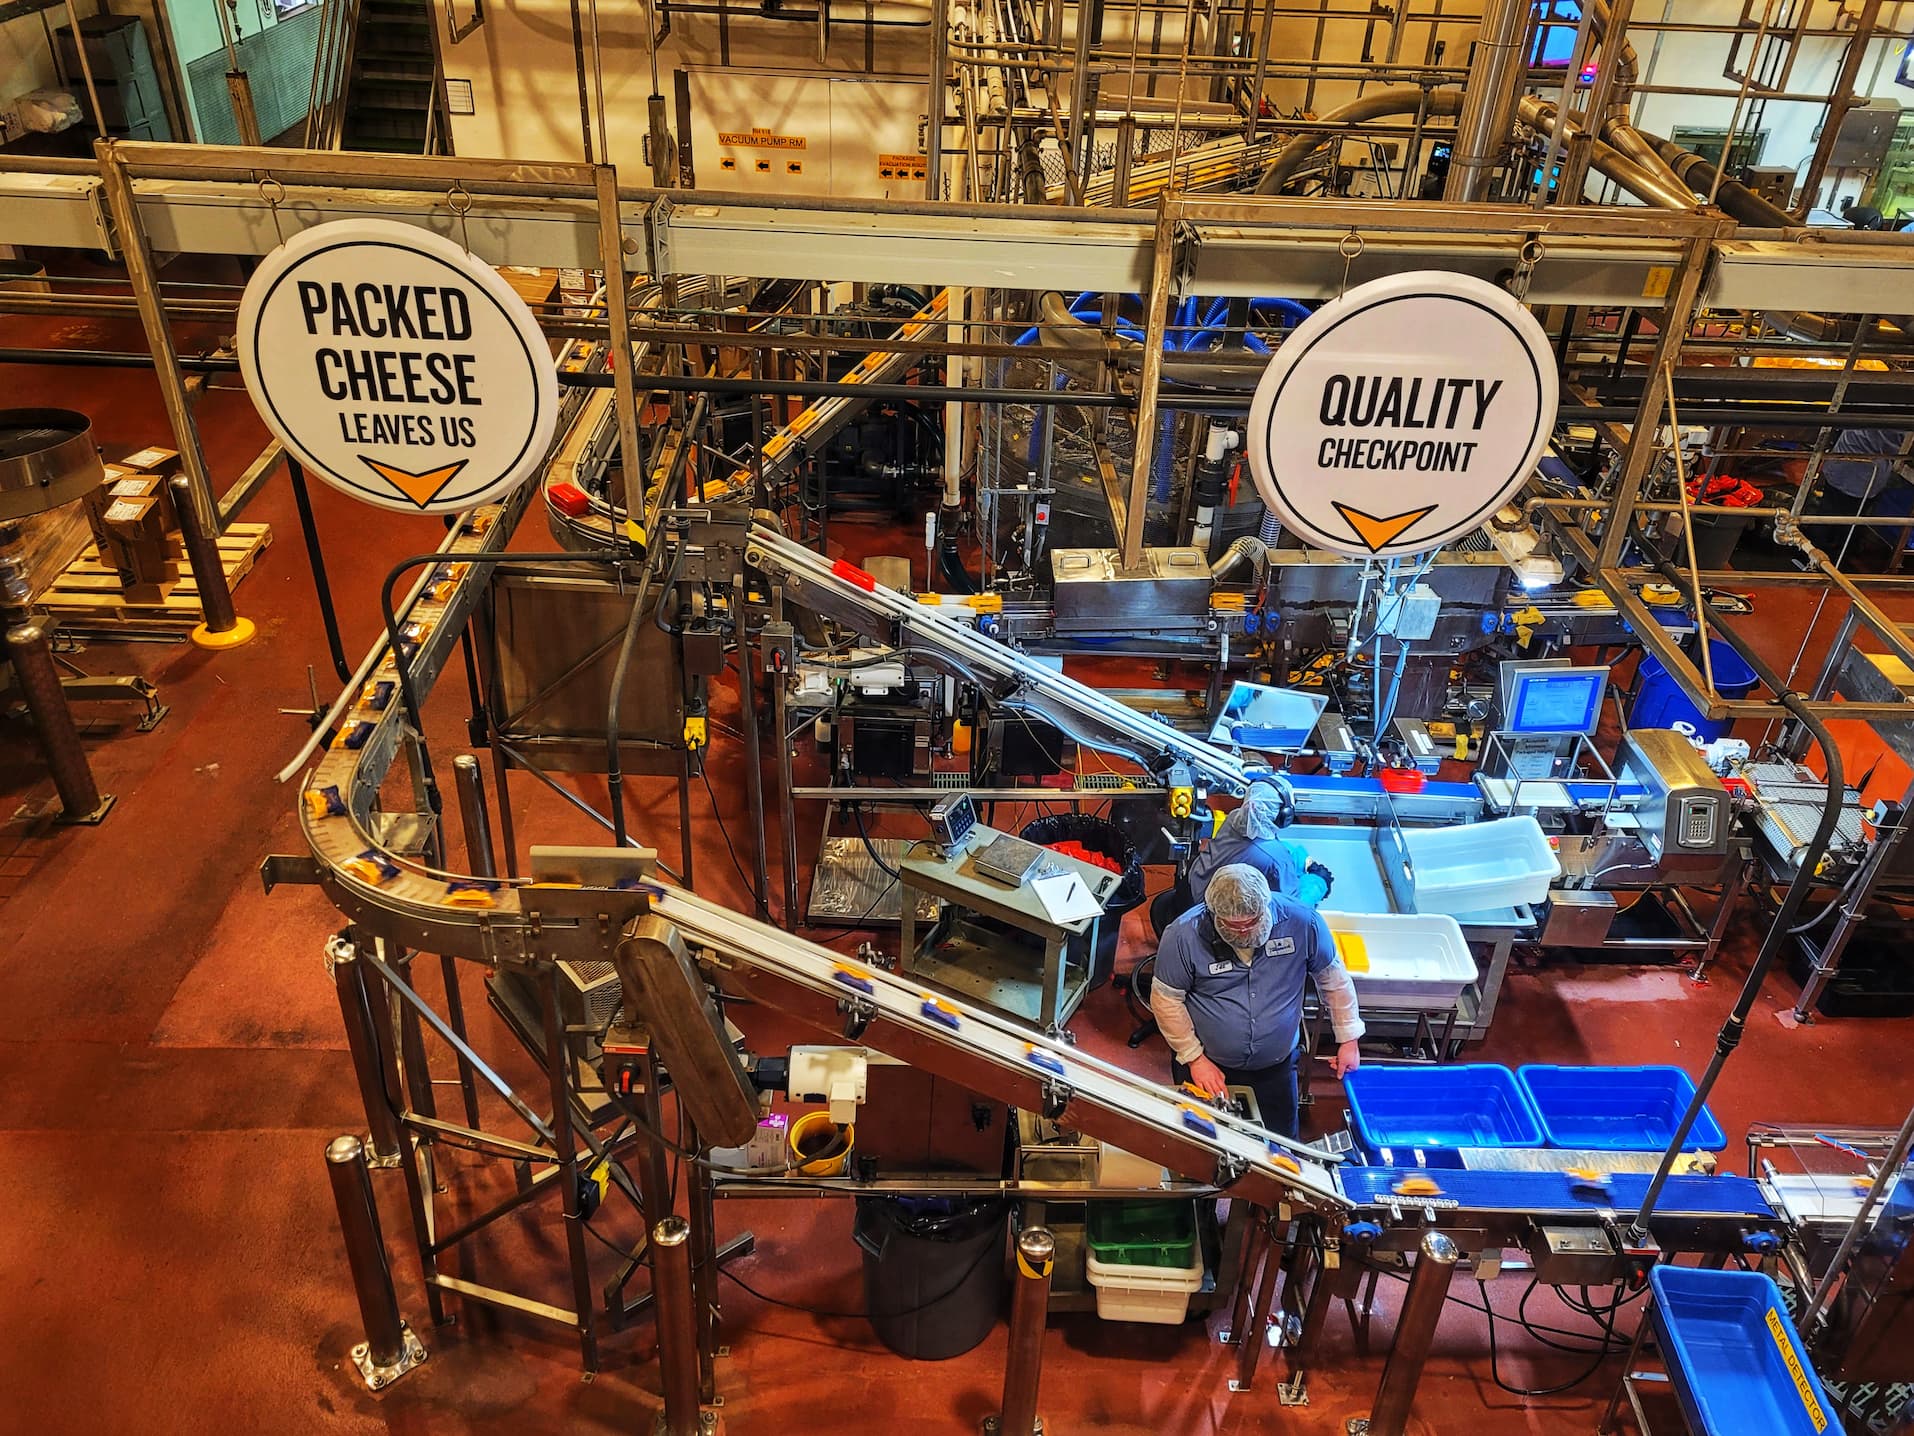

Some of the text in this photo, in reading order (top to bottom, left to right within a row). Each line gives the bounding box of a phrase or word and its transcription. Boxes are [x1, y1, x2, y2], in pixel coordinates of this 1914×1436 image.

[719, 135, 803, 147] VACUUM PUMP RM
[297, 280, 472, 341] PACKED
[315, 347, 482, 406] CHEESE
[1319, 374, 1503, 430] QUALITY
[338, 412, 476, 448] LEAVES US
[1317, 437, 1478, 472] CHECKPOINT
[1767, 1310, 1826, 1431] METAL DETECTOR
